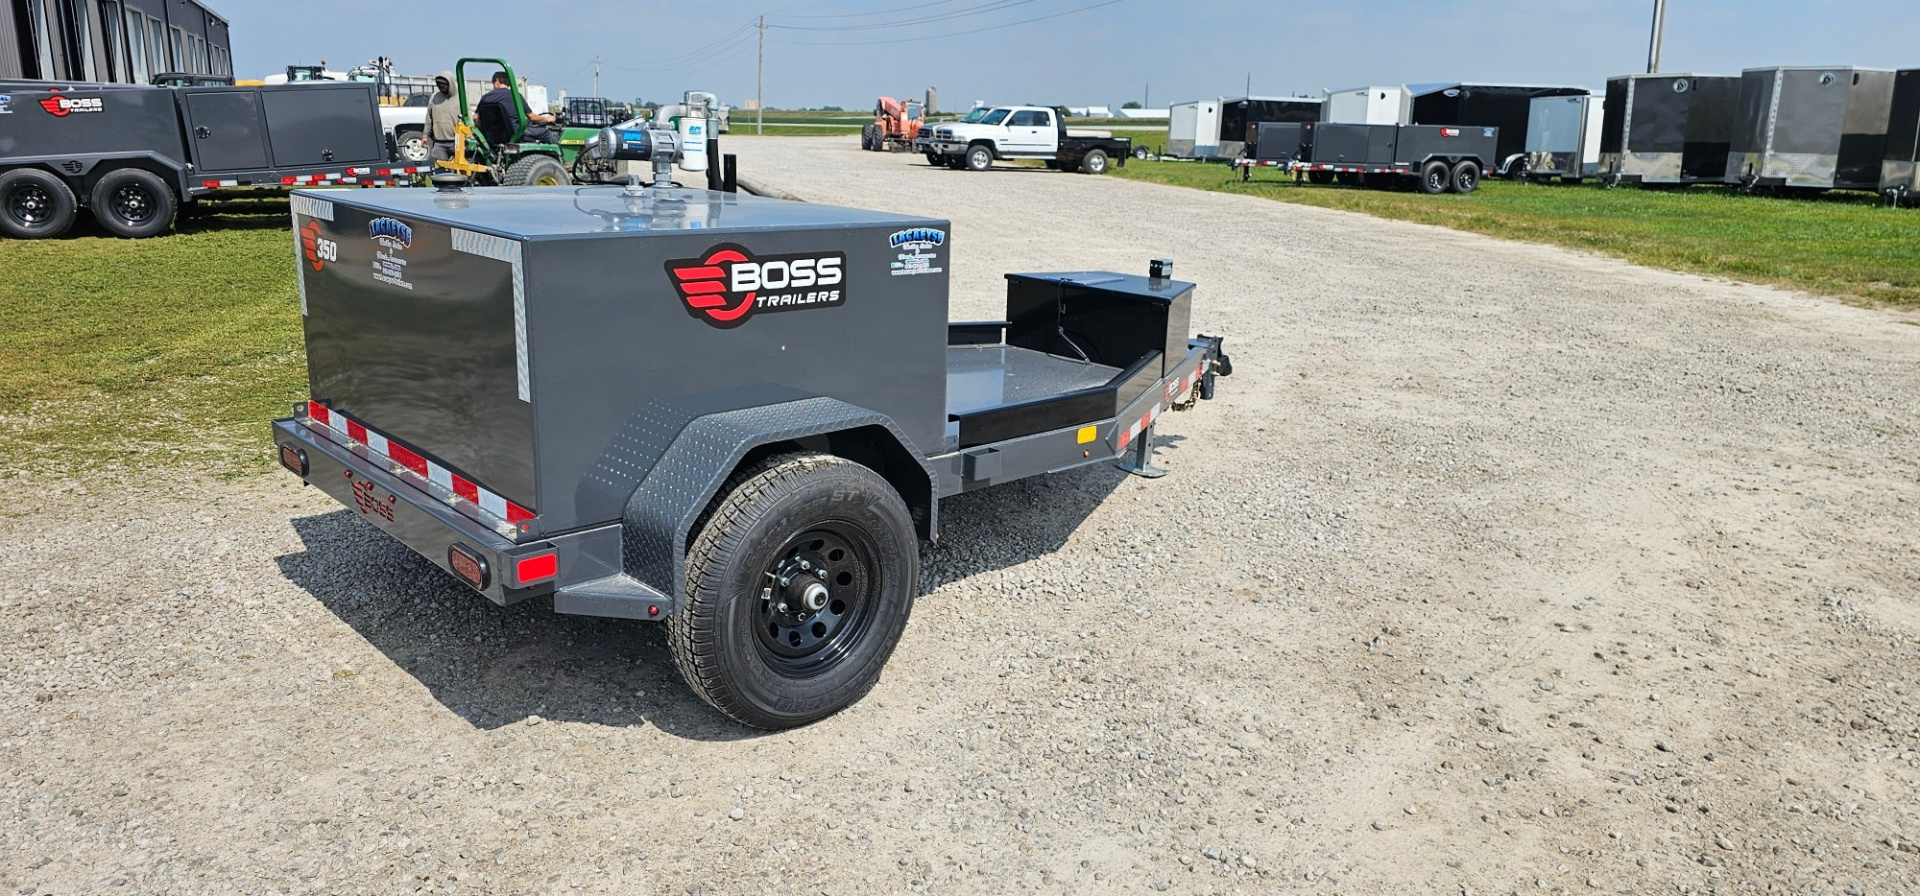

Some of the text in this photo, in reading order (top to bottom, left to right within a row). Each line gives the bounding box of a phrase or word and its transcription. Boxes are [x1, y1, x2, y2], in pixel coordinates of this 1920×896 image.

[59, 98, 103, 108] BOSS
[316, 237, 337, 262] 350
[731, 257, 842, 293] BOSS
[755, 290, 840, 308] TRAILERS
[363, 491, 395, 523] BOSS
